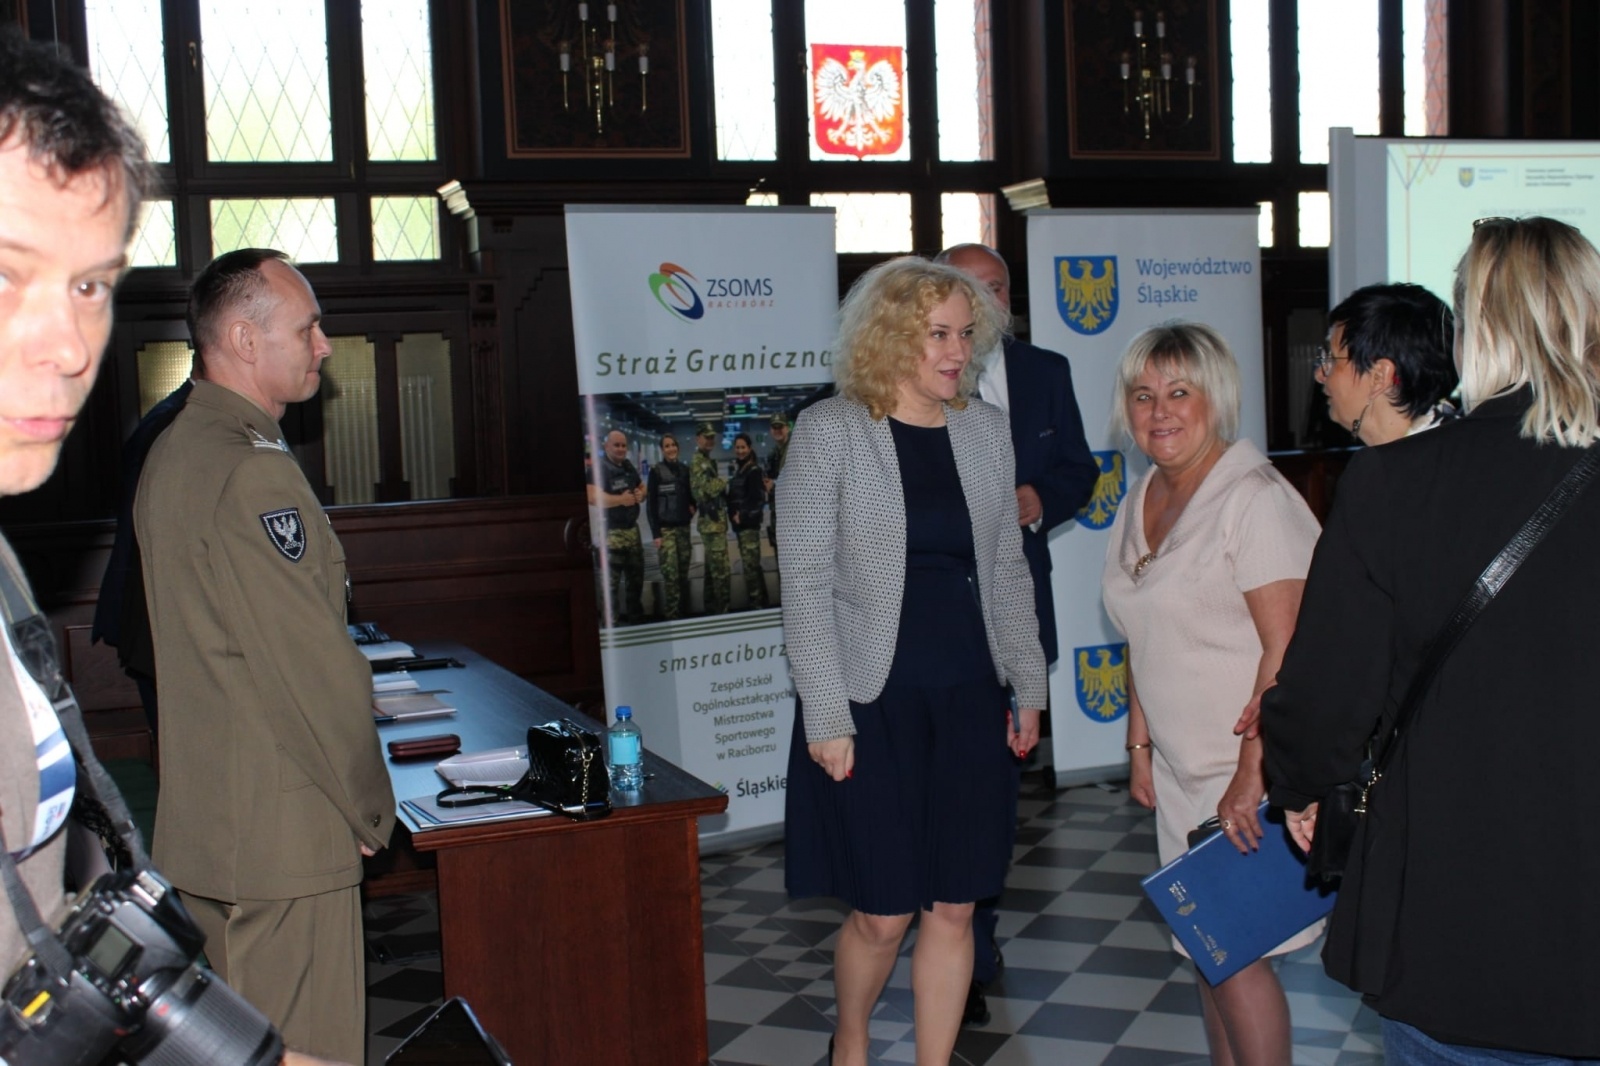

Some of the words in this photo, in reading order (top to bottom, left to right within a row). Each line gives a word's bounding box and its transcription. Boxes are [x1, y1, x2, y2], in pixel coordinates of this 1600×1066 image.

[1136, 257, 1252, 279] Województwo
[706, 278, 773, 297] ZSOMS
[1137, 283, 1198, 307] Śląskie
[595, 349, 677, 376] Straż
[710, 677, 744, 693] Zespół
[745, 673, 773, 688] Szkół
[713, 710, 774, 727] Mistrzostwa
[714, 726, 776, 745] Sportowego
[716, 752, 726, 760] w
[727, 743, 777, 759] Raciborzu
[736, 774, 788, 798] Śląskie
